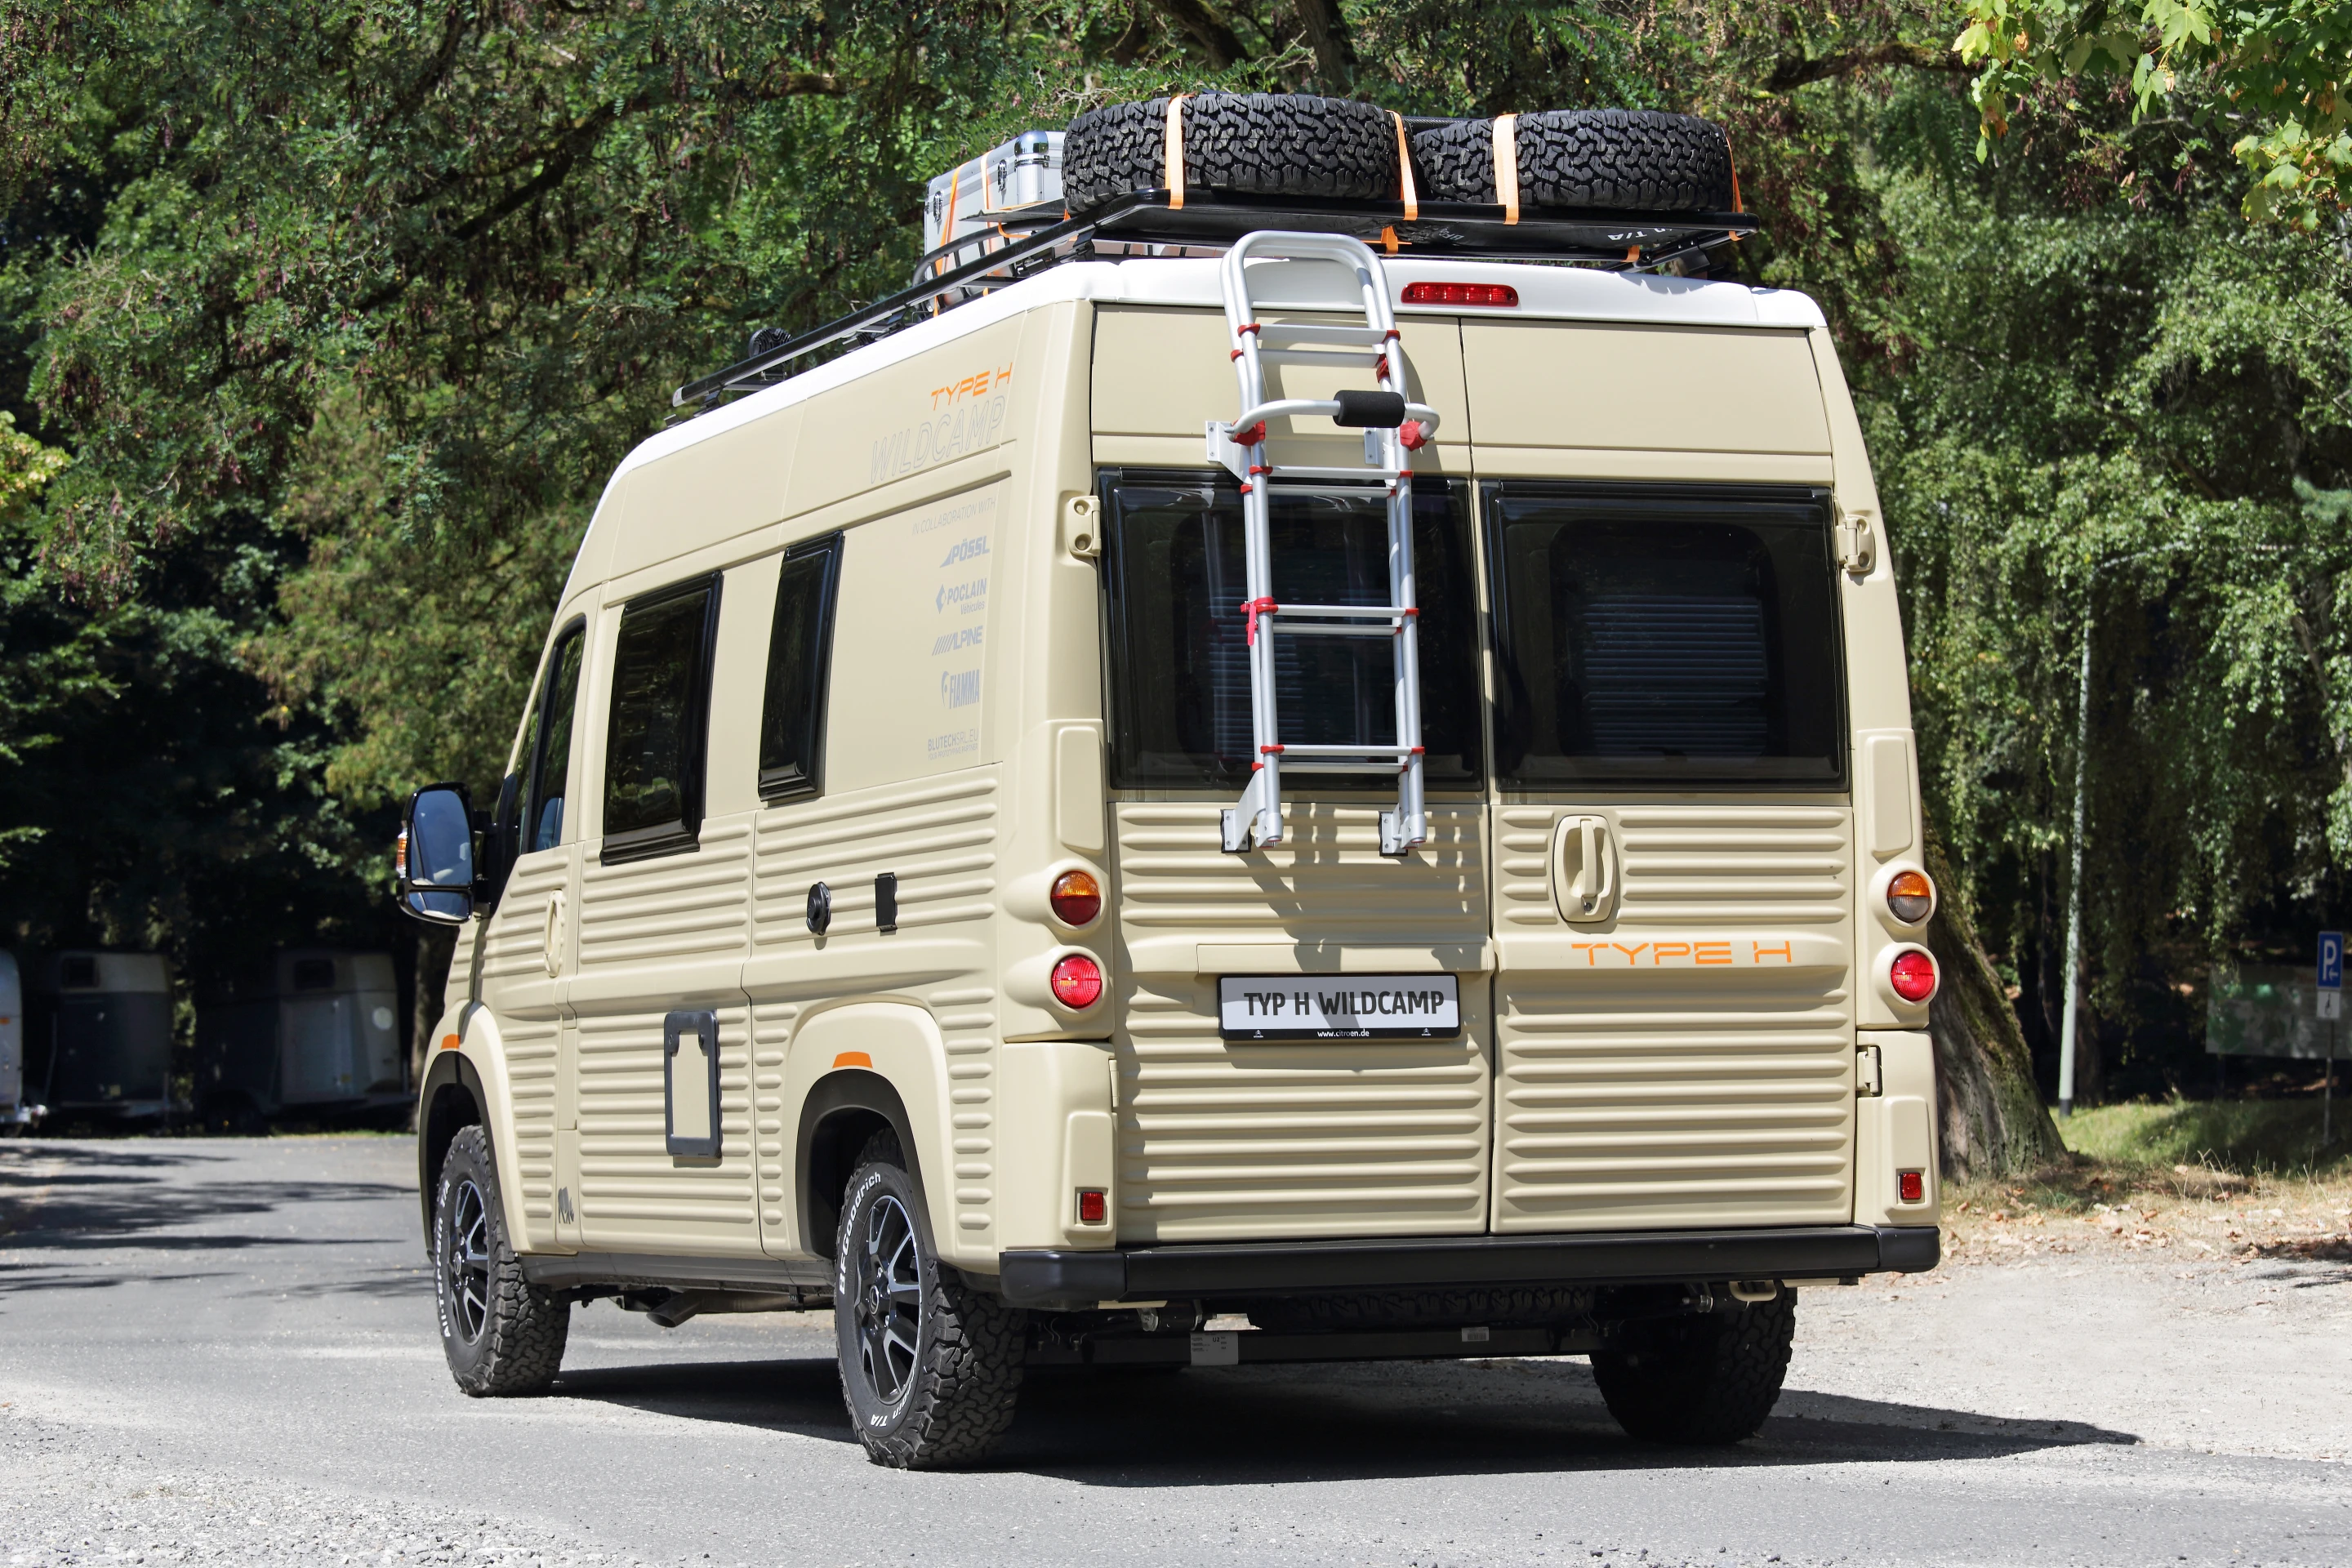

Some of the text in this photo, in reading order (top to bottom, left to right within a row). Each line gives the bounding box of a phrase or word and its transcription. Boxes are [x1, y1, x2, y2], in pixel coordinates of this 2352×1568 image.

[1607, 230, 1647, 241] T/A
[931, 362, 1013, 411] TYPE H
[871, 394, 1005, 484] WILDCAMP
[912, 497, 996, 536] IN COLLABORATION WITH
[947, 535, 991, 565] PÖSSL
[947, 577, 987, 604] POCLAIN
[938, 626, 983, 655] ALPINE
[949, 669, 980, 709] FIAMMA
[928, 728, 979, 752] BLUTECHSRL.EU
[962, 742, 978, 753] PARTNER
[1571, 940, 1792, 966] TYPE H
[2323, 939, 2337, 982] P
[1244, 991, 1445, 1016] TYP H WILDCAMP
[1316, 1028, 1370, 1038] www.citroen.de
[839, 1171, 882, 1296] BFGoodrich
[436, 1179, 451, 1338] All-Terrain T/A
[870, 1414, 888, 1428] T/A
